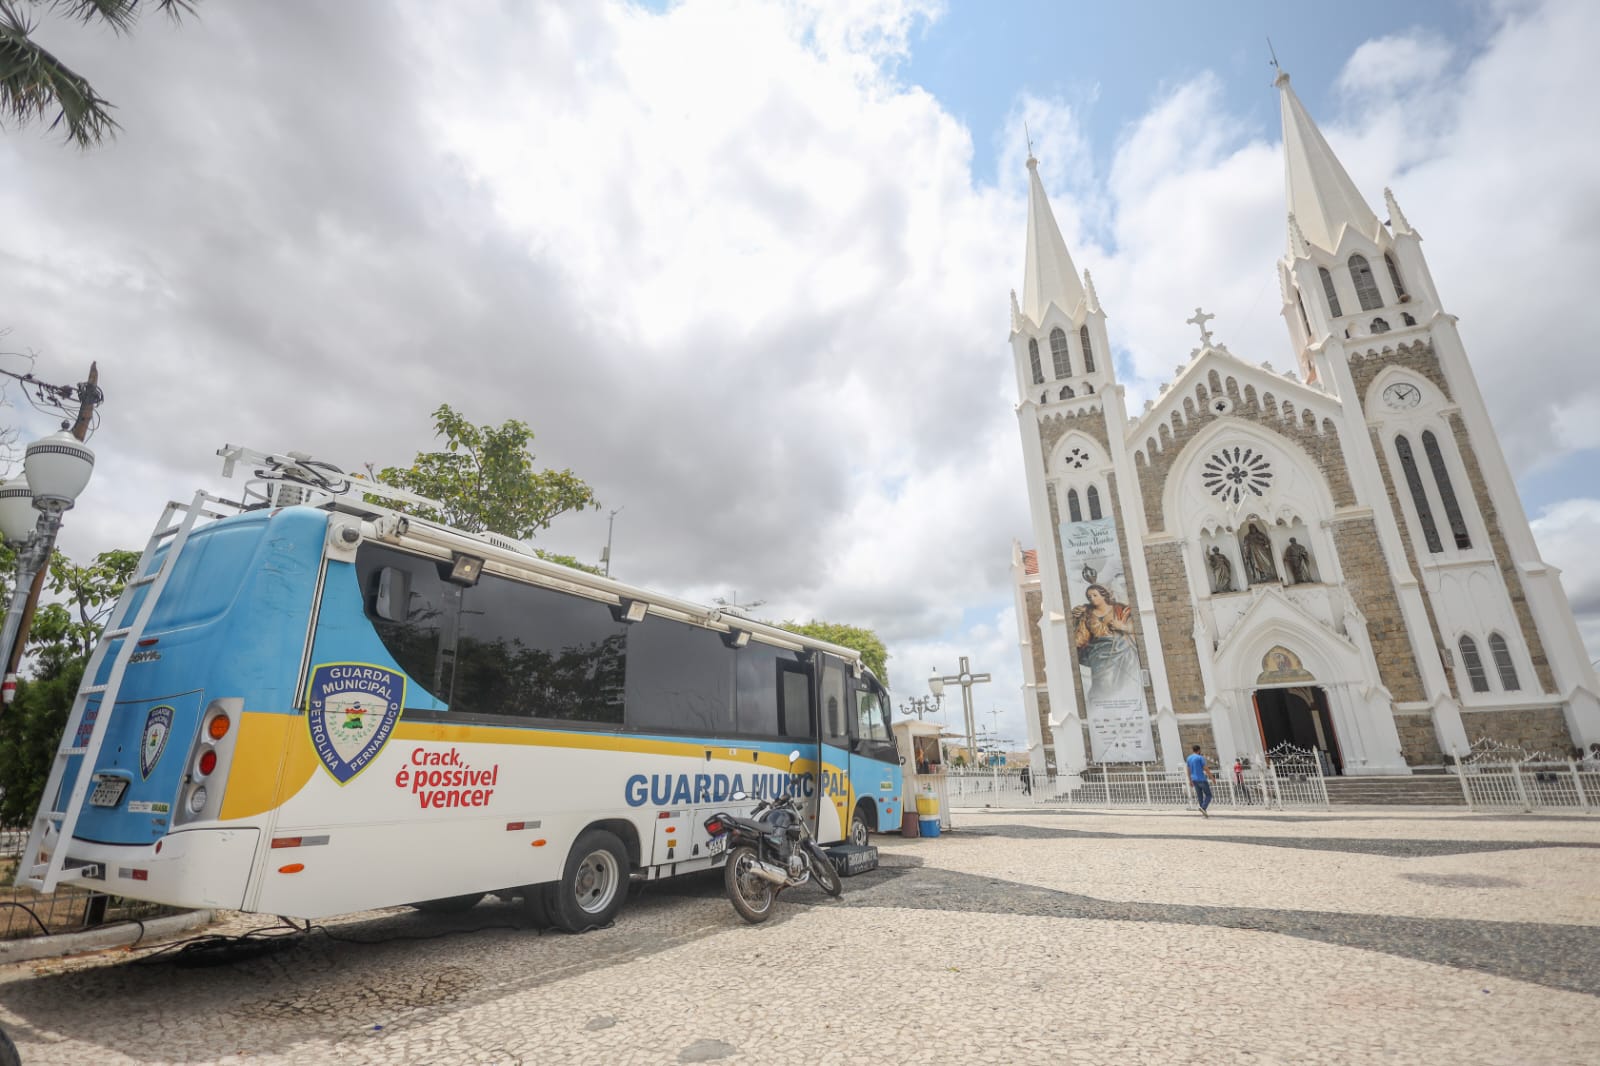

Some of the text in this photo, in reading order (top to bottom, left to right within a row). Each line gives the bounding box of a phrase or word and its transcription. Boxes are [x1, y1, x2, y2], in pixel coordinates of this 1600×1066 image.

[330, 667, 391, 685] GUARDA
[322, 679, 392, 700] MUNICIPAL
[311, 700, 339, 770] PETROLINA
[350, 702, 398, 772] PERNAMBUCO
[411, 747, 464, 768] Crack,
[395, 764, 499, 794] é possível
[624, 773, 746, 807] GUARDA
[418, 788, 494, 809] vencer
